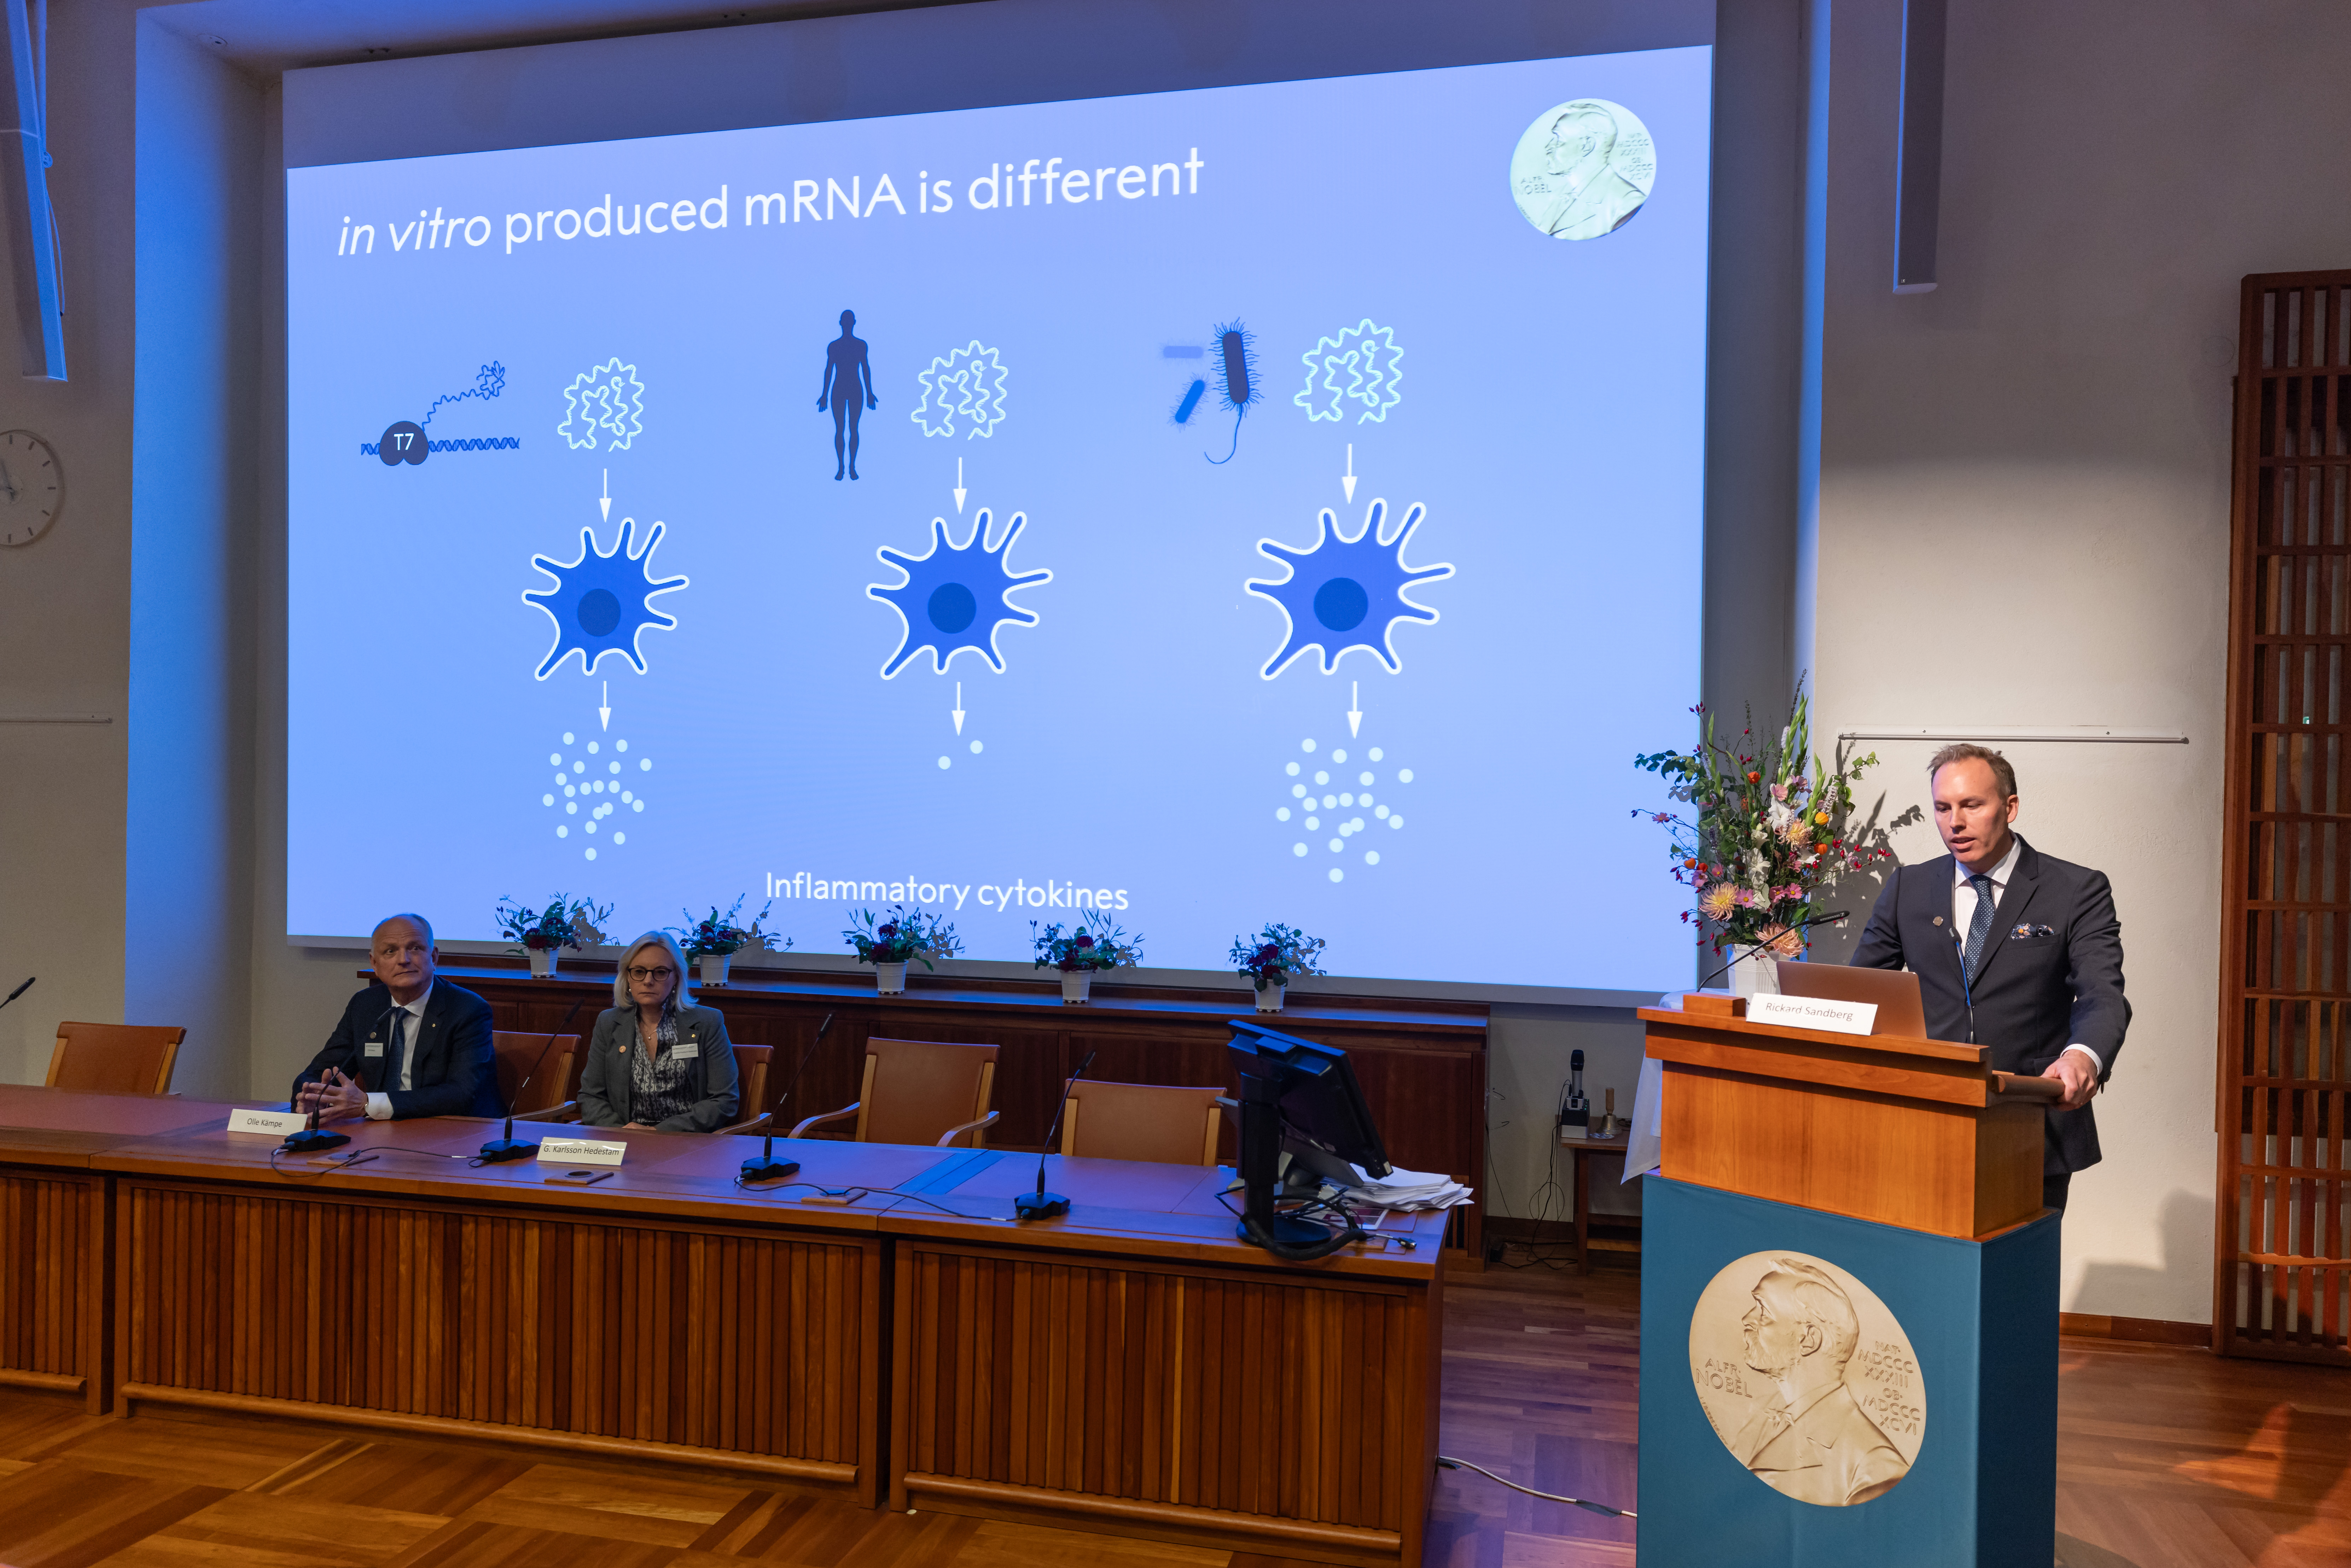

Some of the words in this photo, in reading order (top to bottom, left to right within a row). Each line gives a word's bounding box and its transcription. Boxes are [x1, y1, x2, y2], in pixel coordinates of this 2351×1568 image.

[1514, 184, 1552, 195] NOBEL
[338, 216, 375, 256] in
[389, 207, 491, 252] vitro
[506, 184, 728, 255] produced
[745, 173, 907, 226] mRNA
[919, 170, 954, 214] is
[968, 147, 1205, 210] different
[394, 433, 414, 450] T7
[767, 871, 971, 911] Inflammatory
[977, 878, 1129, 913] cytokines
[1765, 1003, 1803, 1014] Rickard
[1804, 1007, 1854, 1022] Sandberg
[261, 1119, 283, 1128] Kämpe
[553, 1146, 582, 1154] Karlsson
[583, 1147, 619, 1155] Hedestam
[1858, 1349, 1914, 1373] MDCCC
[1696, 1368, 1753, 1398] NOBEL
[1864, 1366, 1908, 1388] XXXIII
[1862, 1395, 1921, 1421] MDCCC
[1879, 1414, 1916, 1435] XCVI
